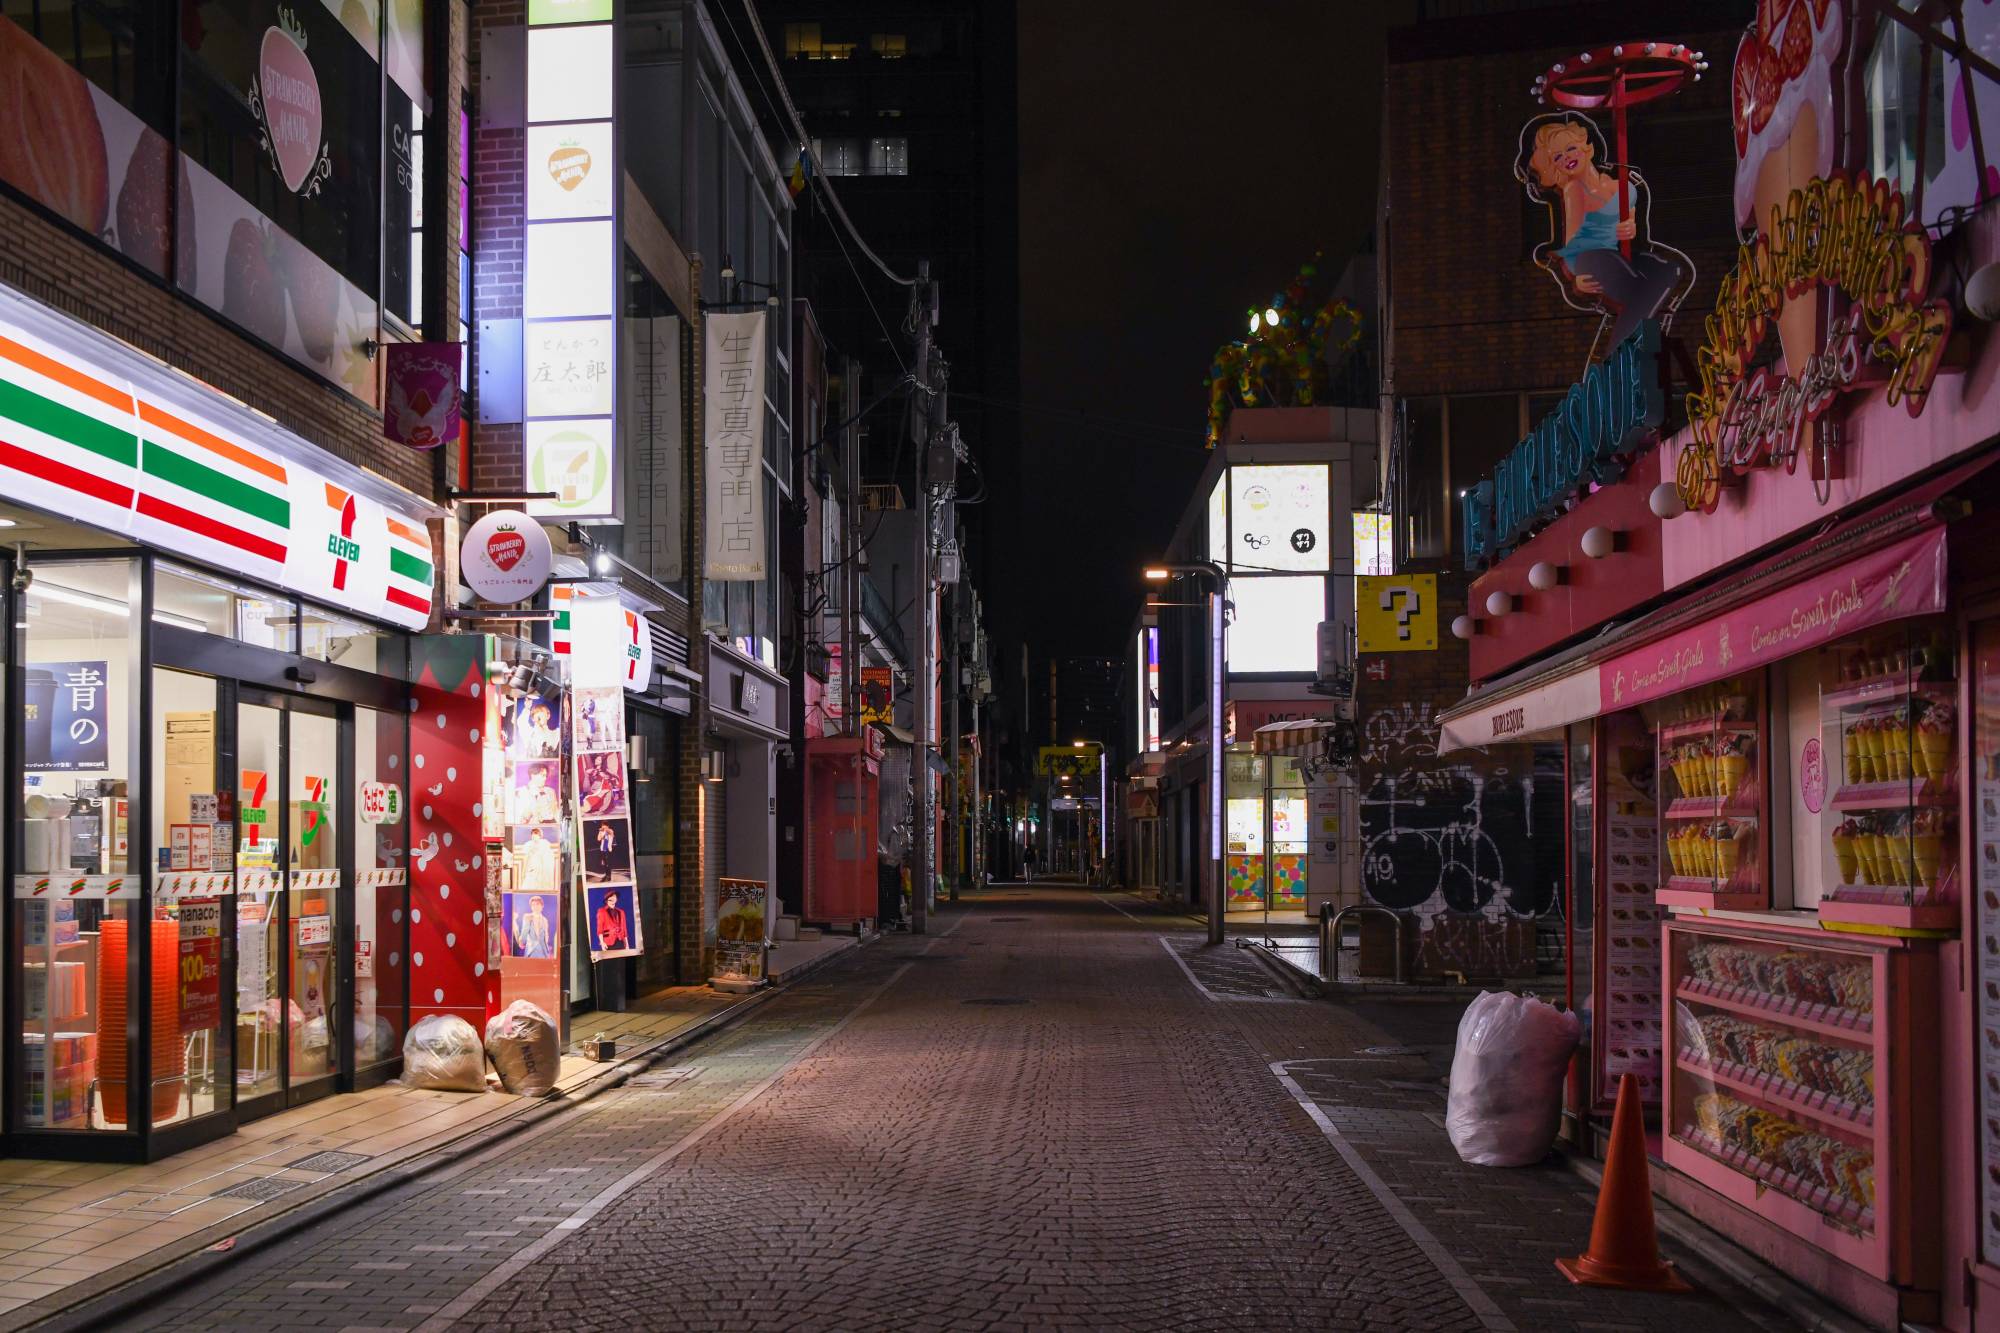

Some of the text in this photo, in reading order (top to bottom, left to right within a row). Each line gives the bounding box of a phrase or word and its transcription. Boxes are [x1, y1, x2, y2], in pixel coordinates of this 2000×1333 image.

[264, 64, 317, 115] STRAWBERRY
[274, 109, 314, 156] MANIA
[543, 338, 600, 352] とんかつ
[532, 360, 608, 385] 庄太郎
[719, 331, 753, 554] 生写真専門店
[1494, 335, 1648, 543] BURLESQUE
[325, 482, 356, 591] 7
[328, 533, 360, 564] ELEVEN
[488, 539, 522, 555] STRAWBERRY
[495, 550, 519, 565] MANIA
[1828, 577, 1863, 636] Girls
[64, 667, 105, 745] 青の
[1492, 707, 1524, 737] BURLESQUE
[242, 770, 267, 847] 7
[242, 808, 267, 825] ELEVEN
[363, 787, 397, 814] たばこ 酒
